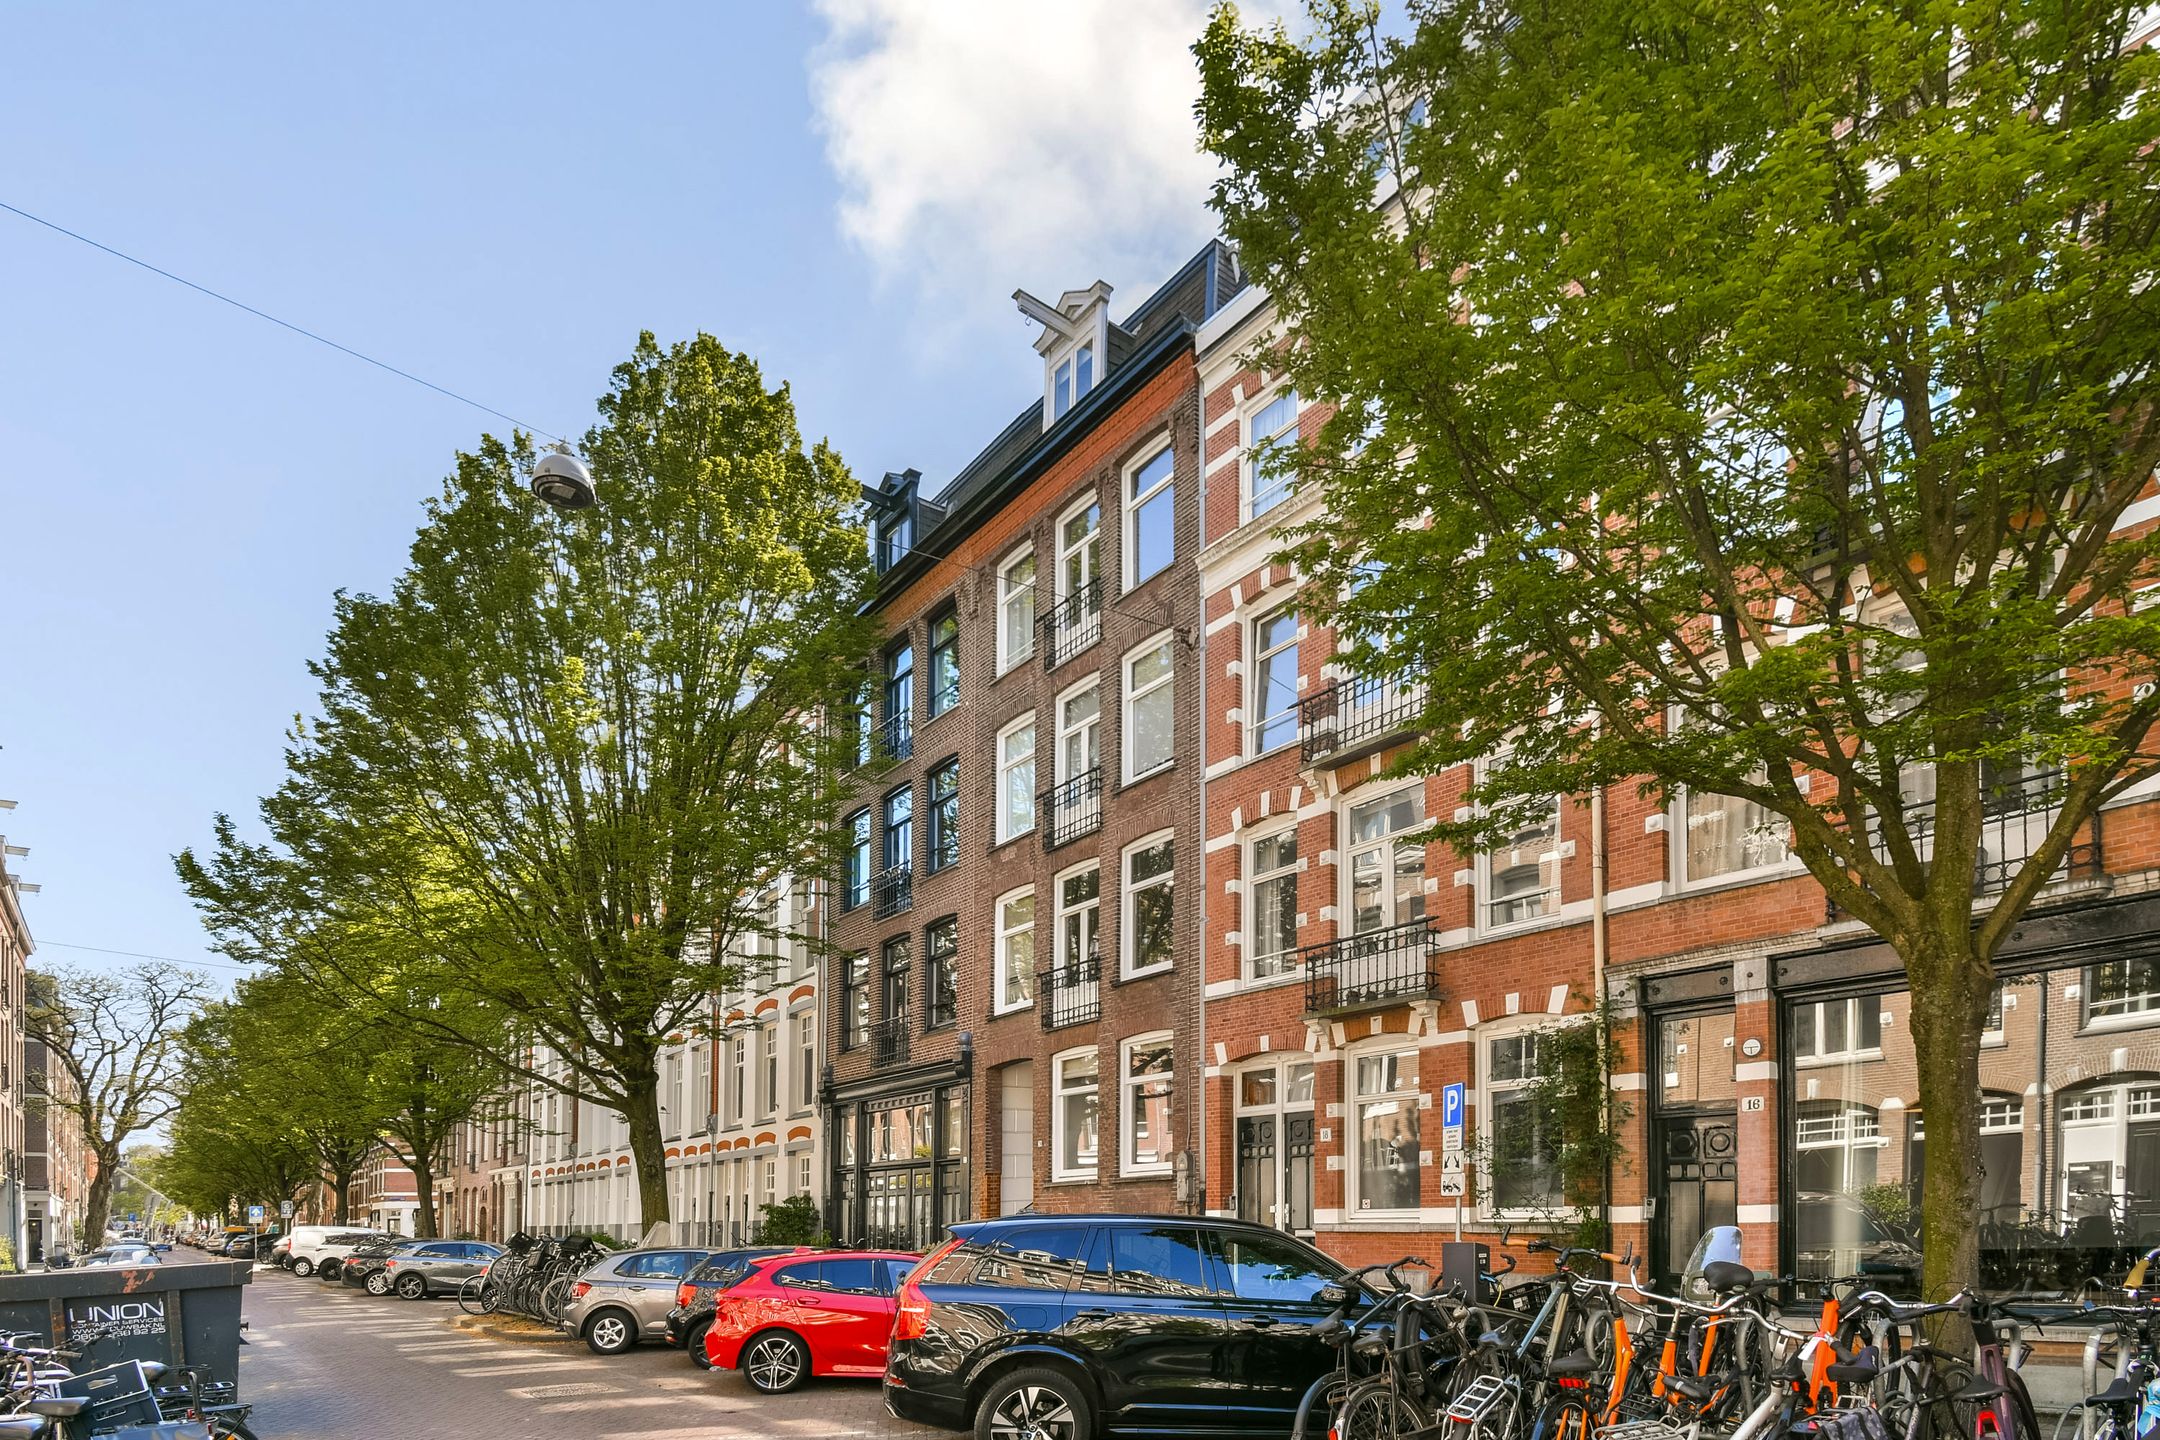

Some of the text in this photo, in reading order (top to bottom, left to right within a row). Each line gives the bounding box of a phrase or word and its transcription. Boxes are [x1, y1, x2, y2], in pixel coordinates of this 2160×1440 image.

[1447, 1089, 1459, 1123] P
[1746, 1098, 1760, 1110] 16
[122, 1317, 165, 1325] SERVICES
[133, 1328, 149, 1336] 92
